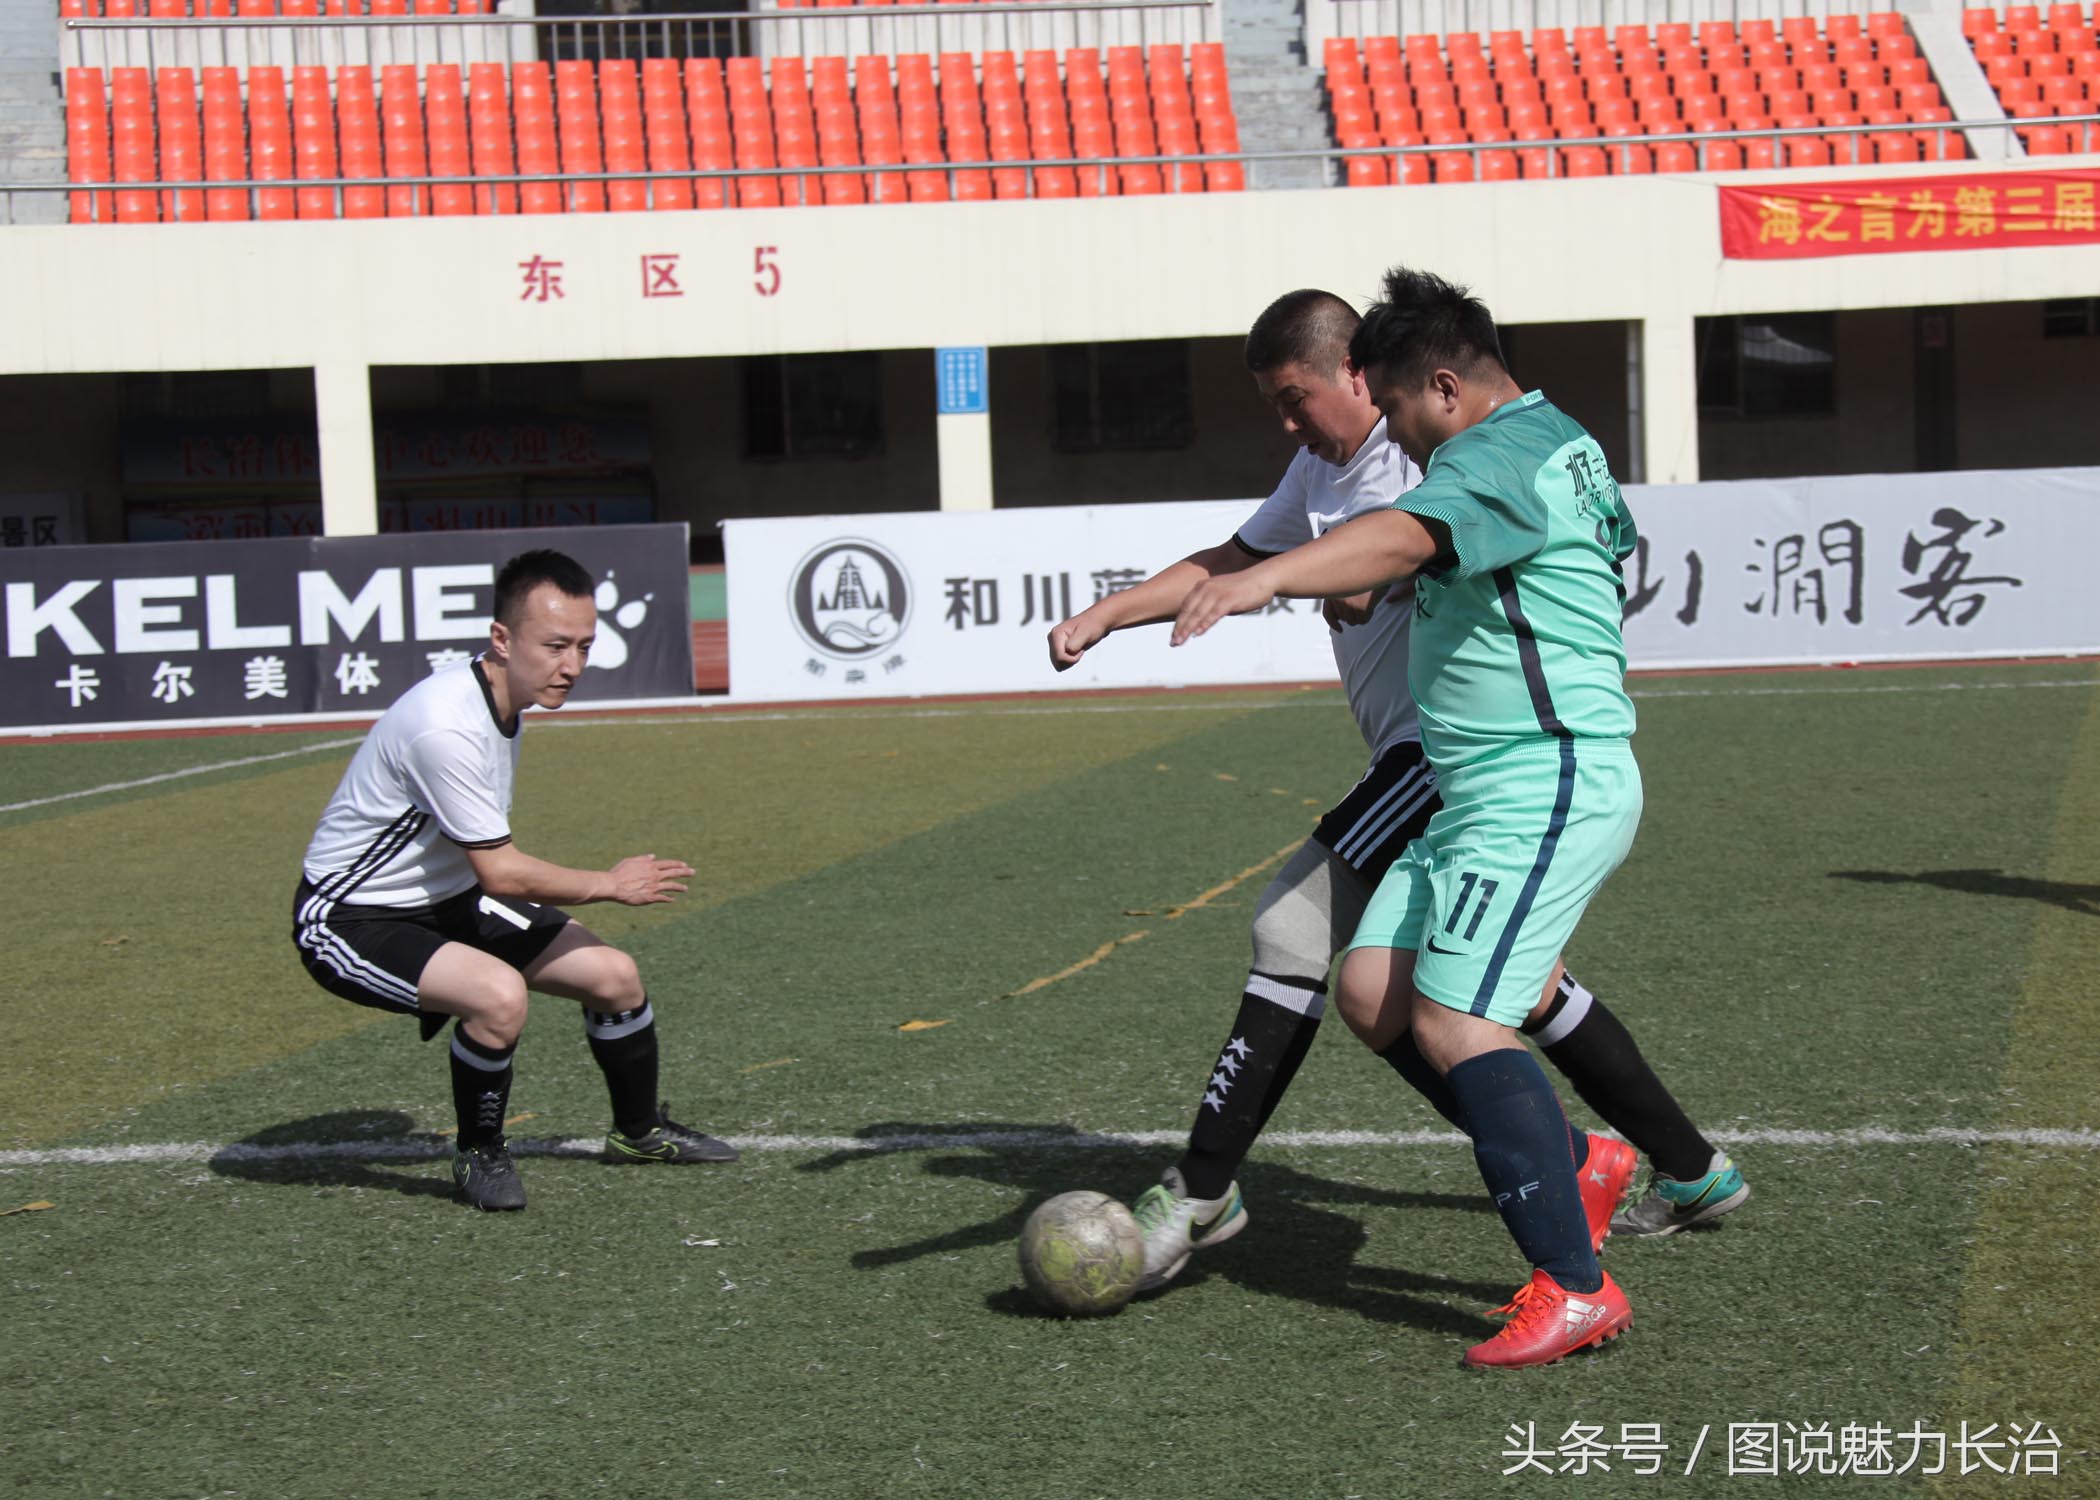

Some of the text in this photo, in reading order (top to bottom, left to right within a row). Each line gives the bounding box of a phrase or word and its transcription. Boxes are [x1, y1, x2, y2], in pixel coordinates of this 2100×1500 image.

[1759, 182, 2095, 245] 海之言为第三届
[518, 246, 781, 302] 东区 5
[6, 563, 494, 658] KELME
[478, 895, 541, 932] 1
[1445, 871, 1500, 943] 11
